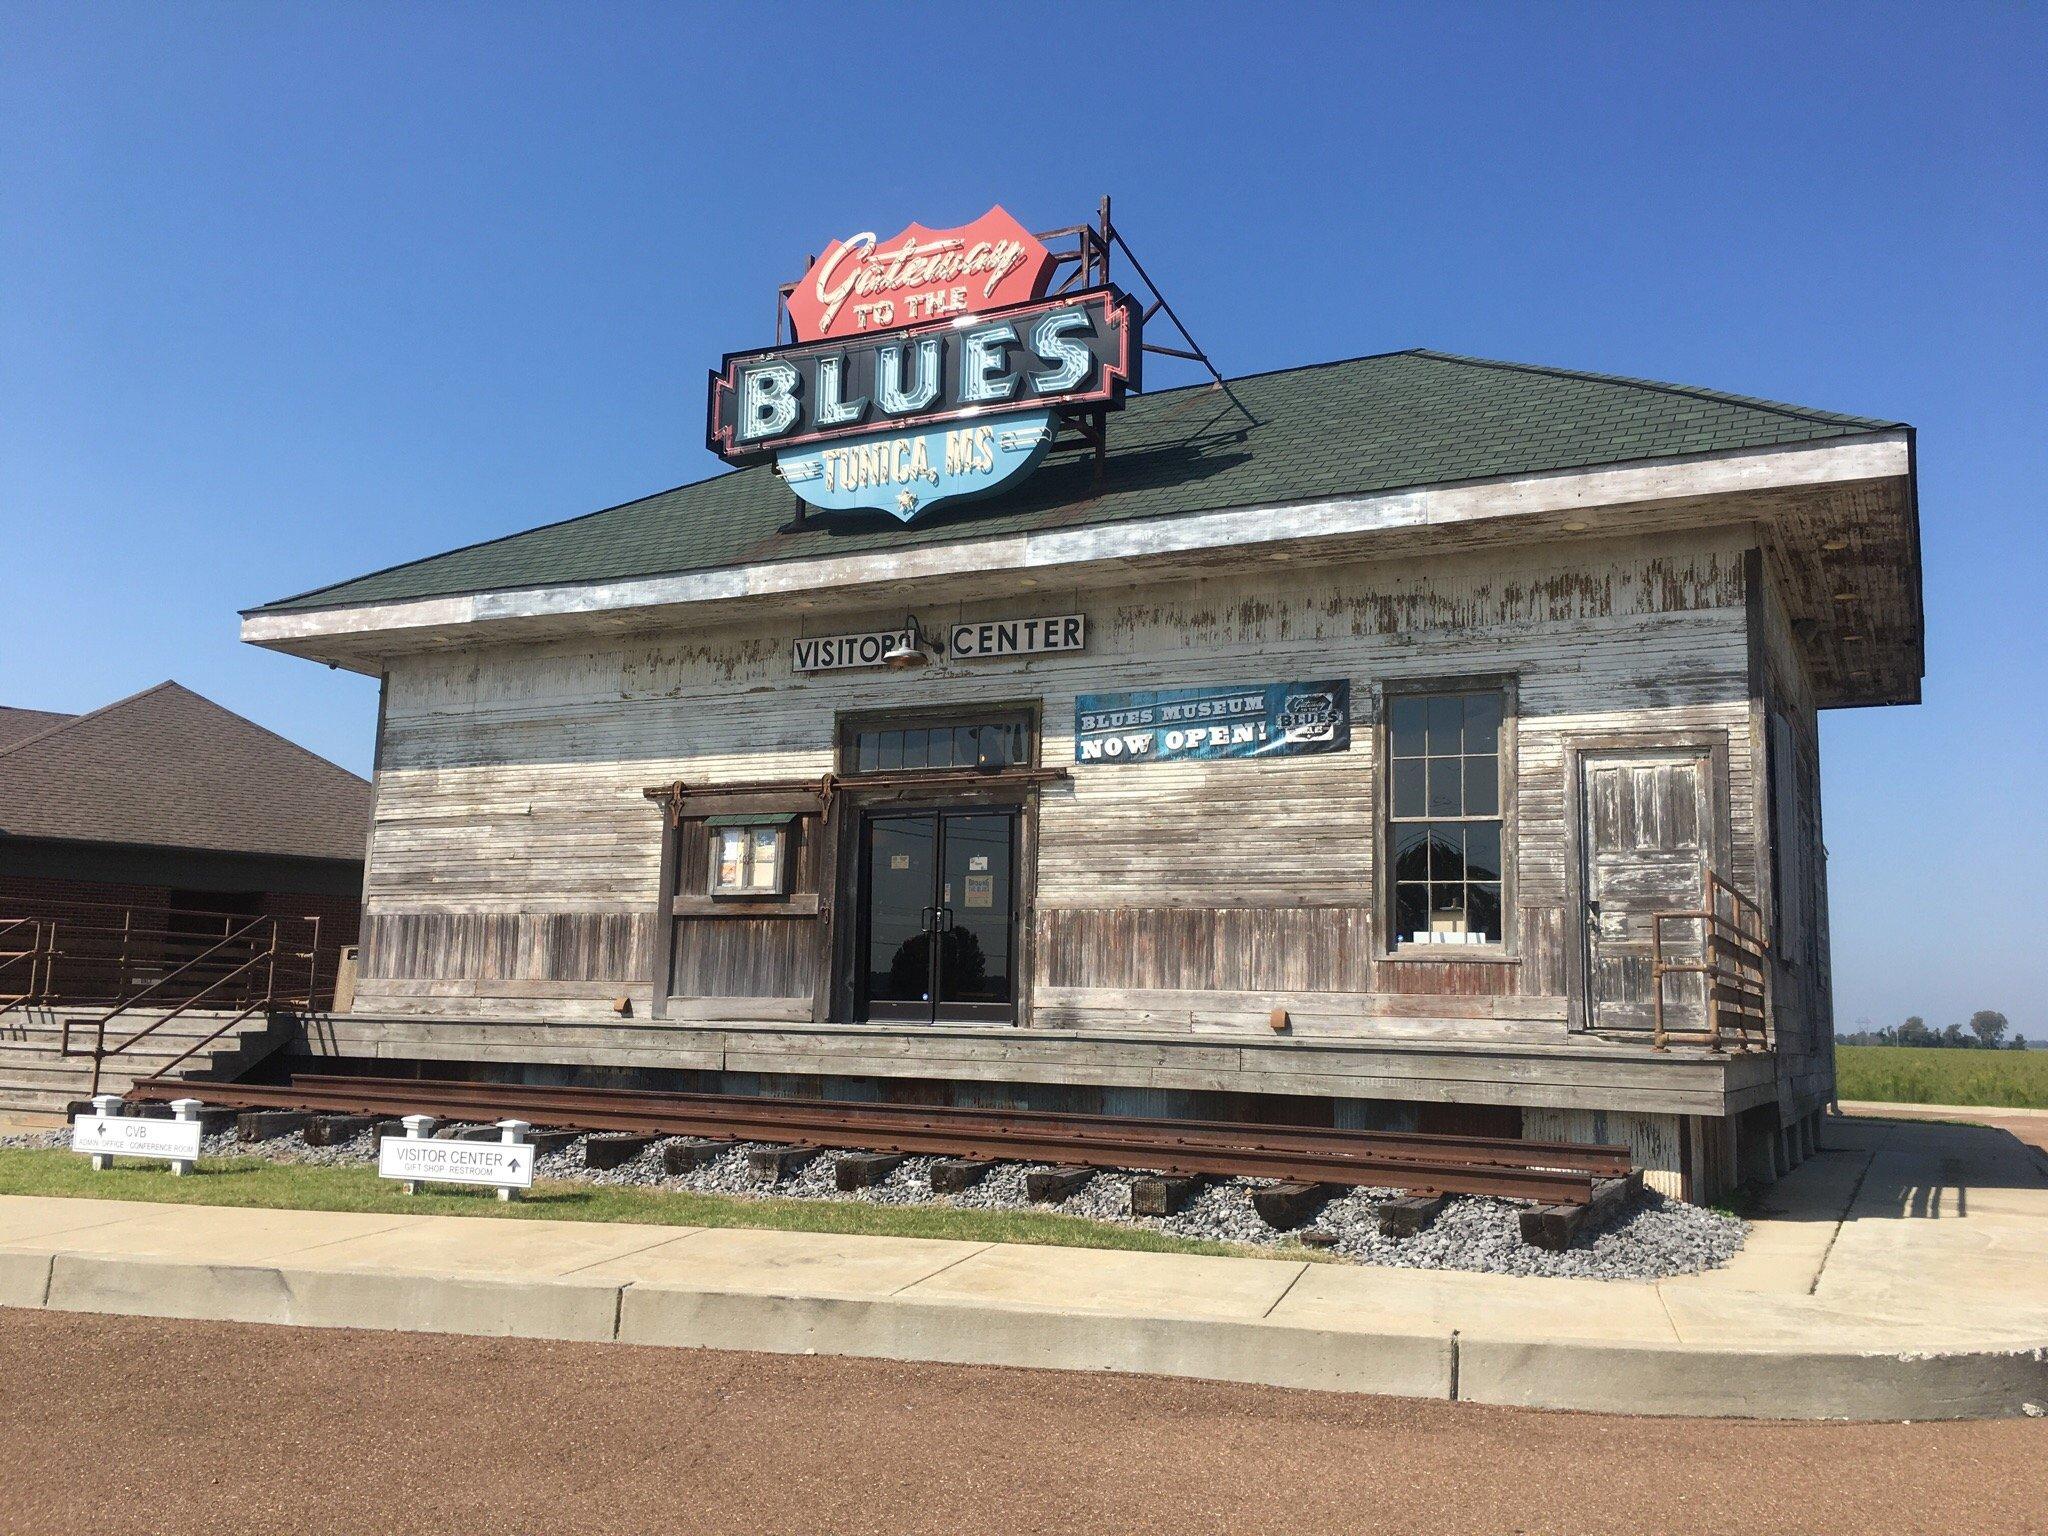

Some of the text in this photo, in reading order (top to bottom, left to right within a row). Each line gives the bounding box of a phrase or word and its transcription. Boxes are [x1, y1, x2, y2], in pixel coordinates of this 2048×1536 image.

[816, 231, 1027, 334] Gateway
[853, 286, 969, 329] TO THE
[735, 305, 1100, 442] BLUES
[822, 426, 995, 494] TUNICA, MS
[953, 618, 1081, 655] CENTER
[1081, 696, 1264, 731] BLUES MUSEUM
[1279, 708, 1340, 728] BLUES
[1081, 721, 1267, 760] NOW OPEN!
[102, 1139, 124, 1149] OFFICE
[129, 1141, 174, 1152] CONFERENCE
[174, 1144, 194, 1153] ROOM
[125, 1125, 147, 1138] CVB
[396, 1148, 503, 1166] VISITOR CENTER
[404, 1162, 493, 1176] GIFT SHOP RESTROOM
